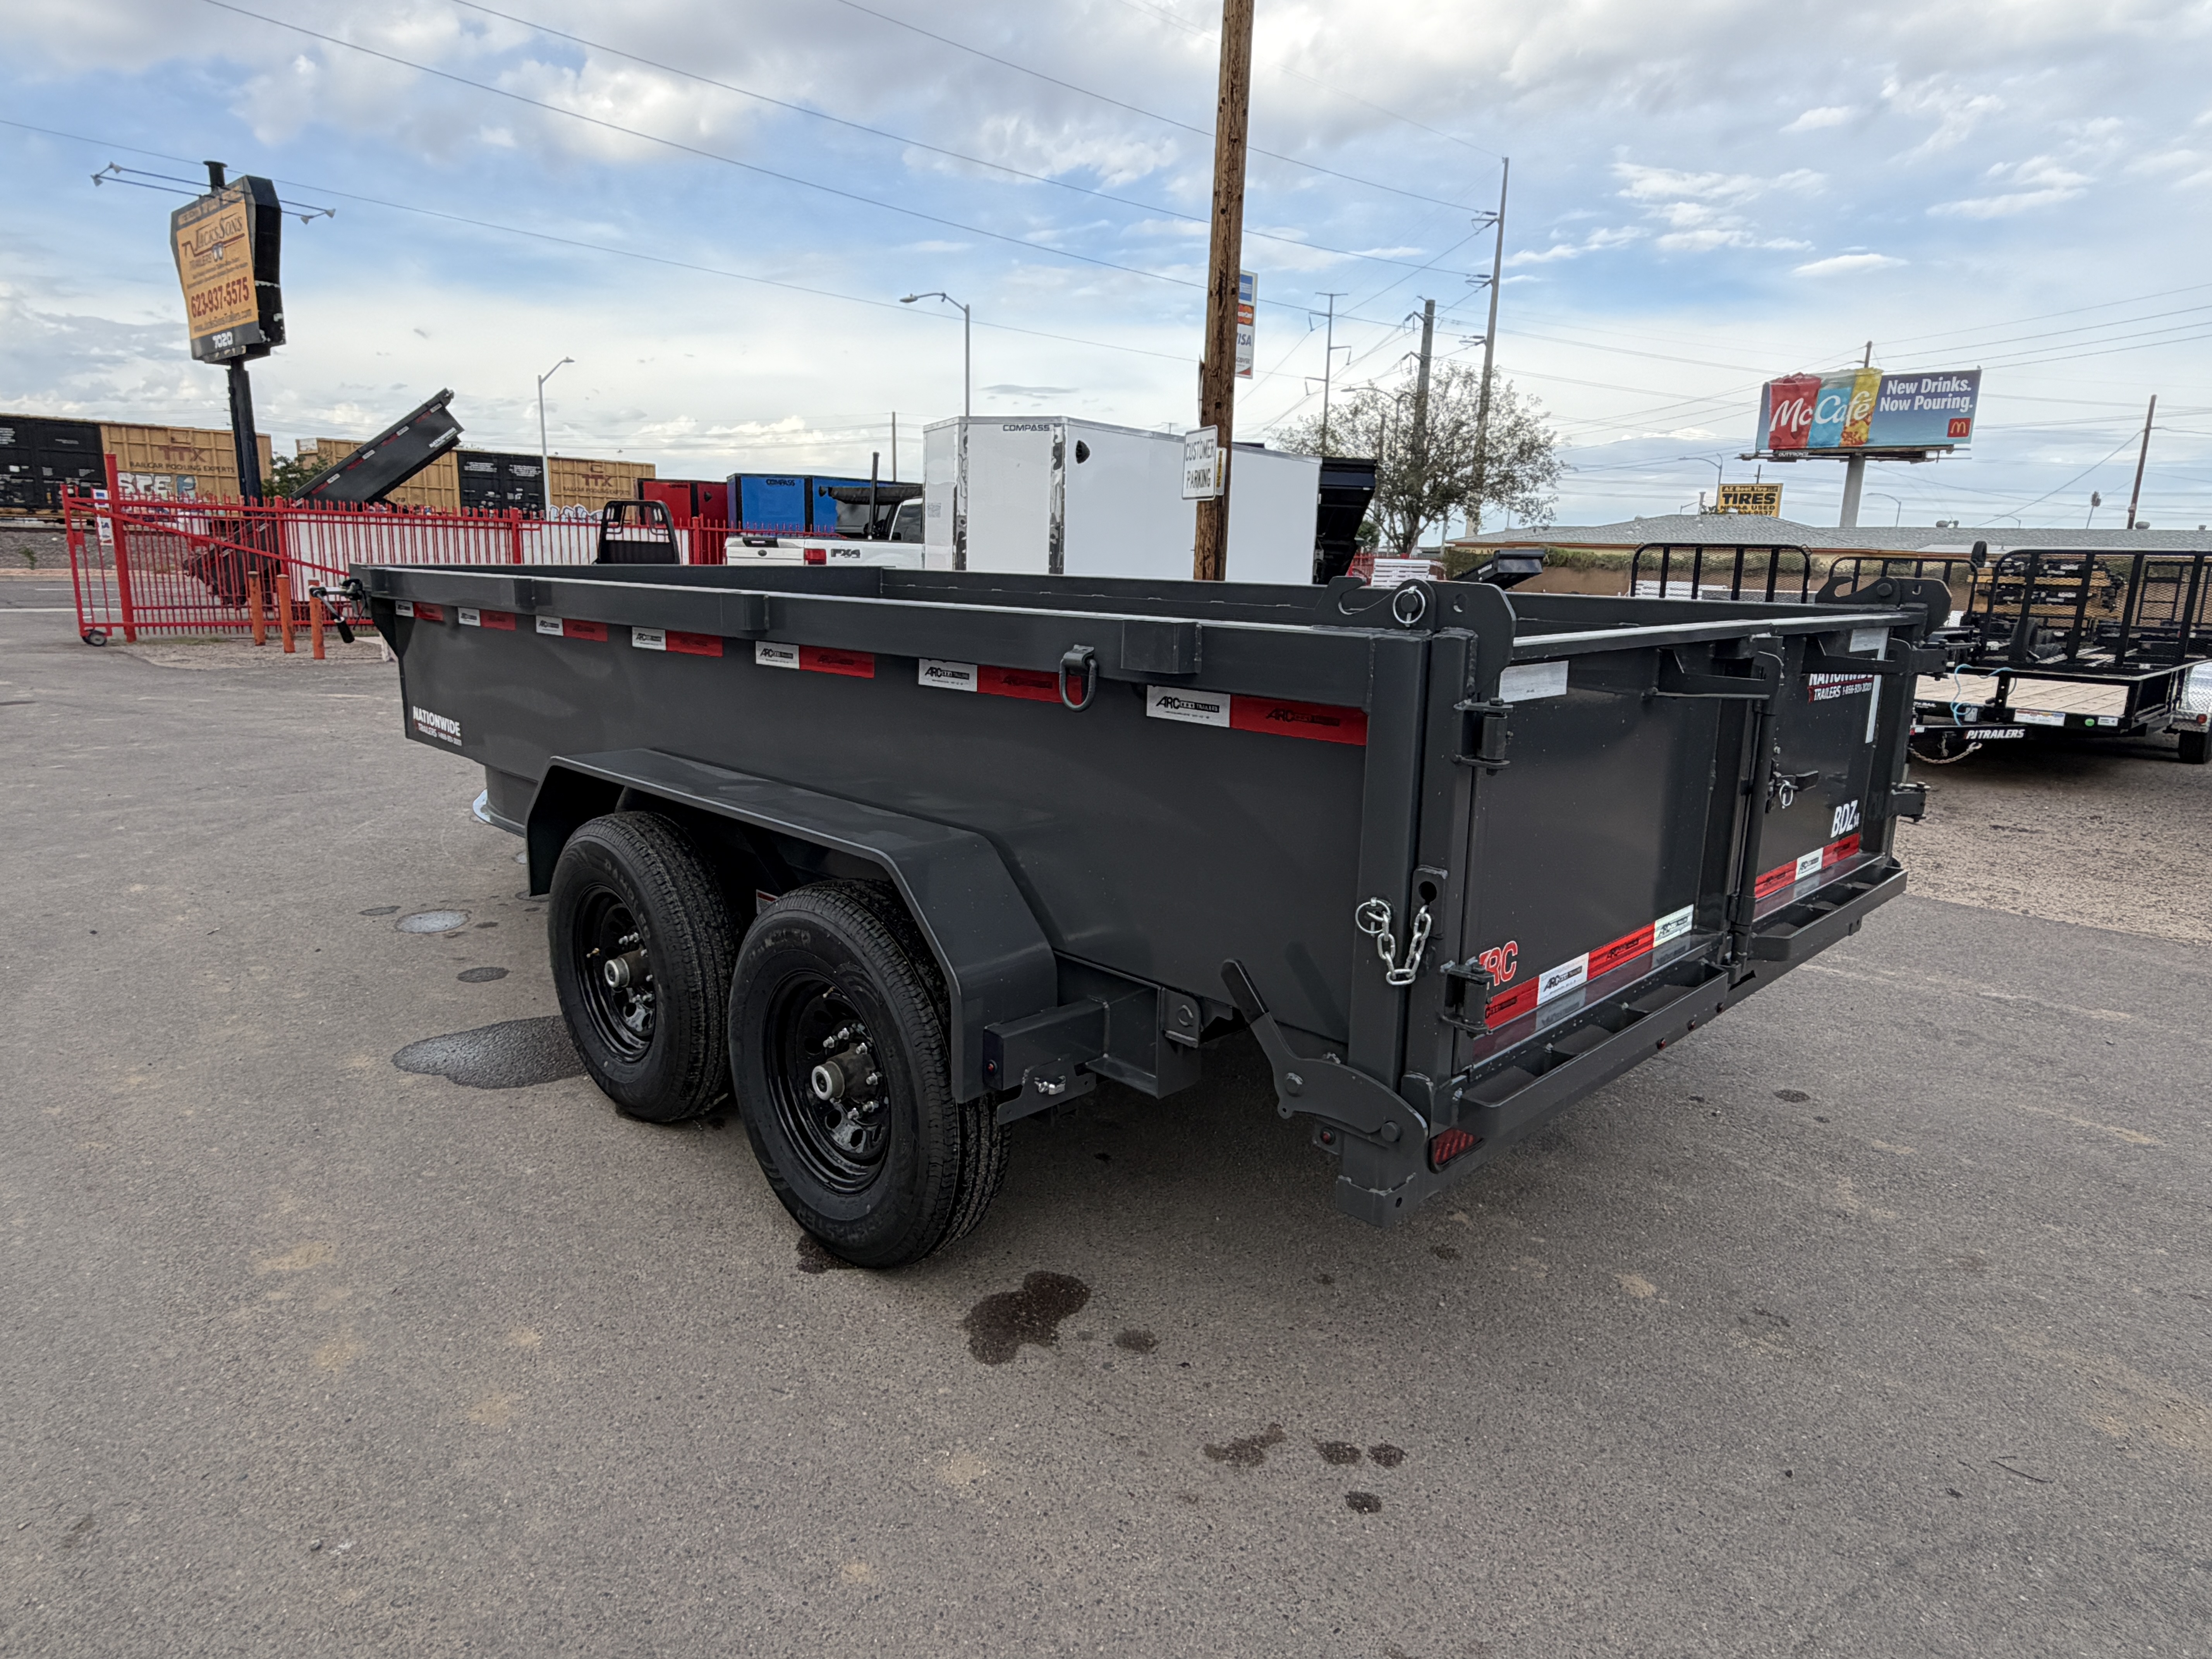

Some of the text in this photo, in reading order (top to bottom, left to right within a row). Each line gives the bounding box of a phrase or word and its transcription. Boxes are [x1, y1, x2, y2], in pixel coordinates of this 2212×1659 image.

[191, 276, 249, 318] 623-937-5575
[213, 331, 233, 349] 7020
[1887, 376, 1972, 395] New Drinks.
[1880, 393, 1973, 413] Now Pouring.
[158, 446, 207, 462] TTX
[1186, 438, 1214, 461] CUSTOMER
[166, 463, 202, 472] POOLING
[582, 474, 613, 487] TTX
[1186, 468, 1211, 489] PARKING
[1723, 493, 1776, 504] TIRES
[831, 549, 860, 558] FX4
[925, 666, 942, 677] ARC
[1156, 696, 1180, 709] ARC
[413, 706, 461, 737] NATIONWIDE
[1978, 729, 2025, 739] TRAILERS
[1831, 800, 1858, 838] BDZ
[1543, 974, 1560, 992] ARC
